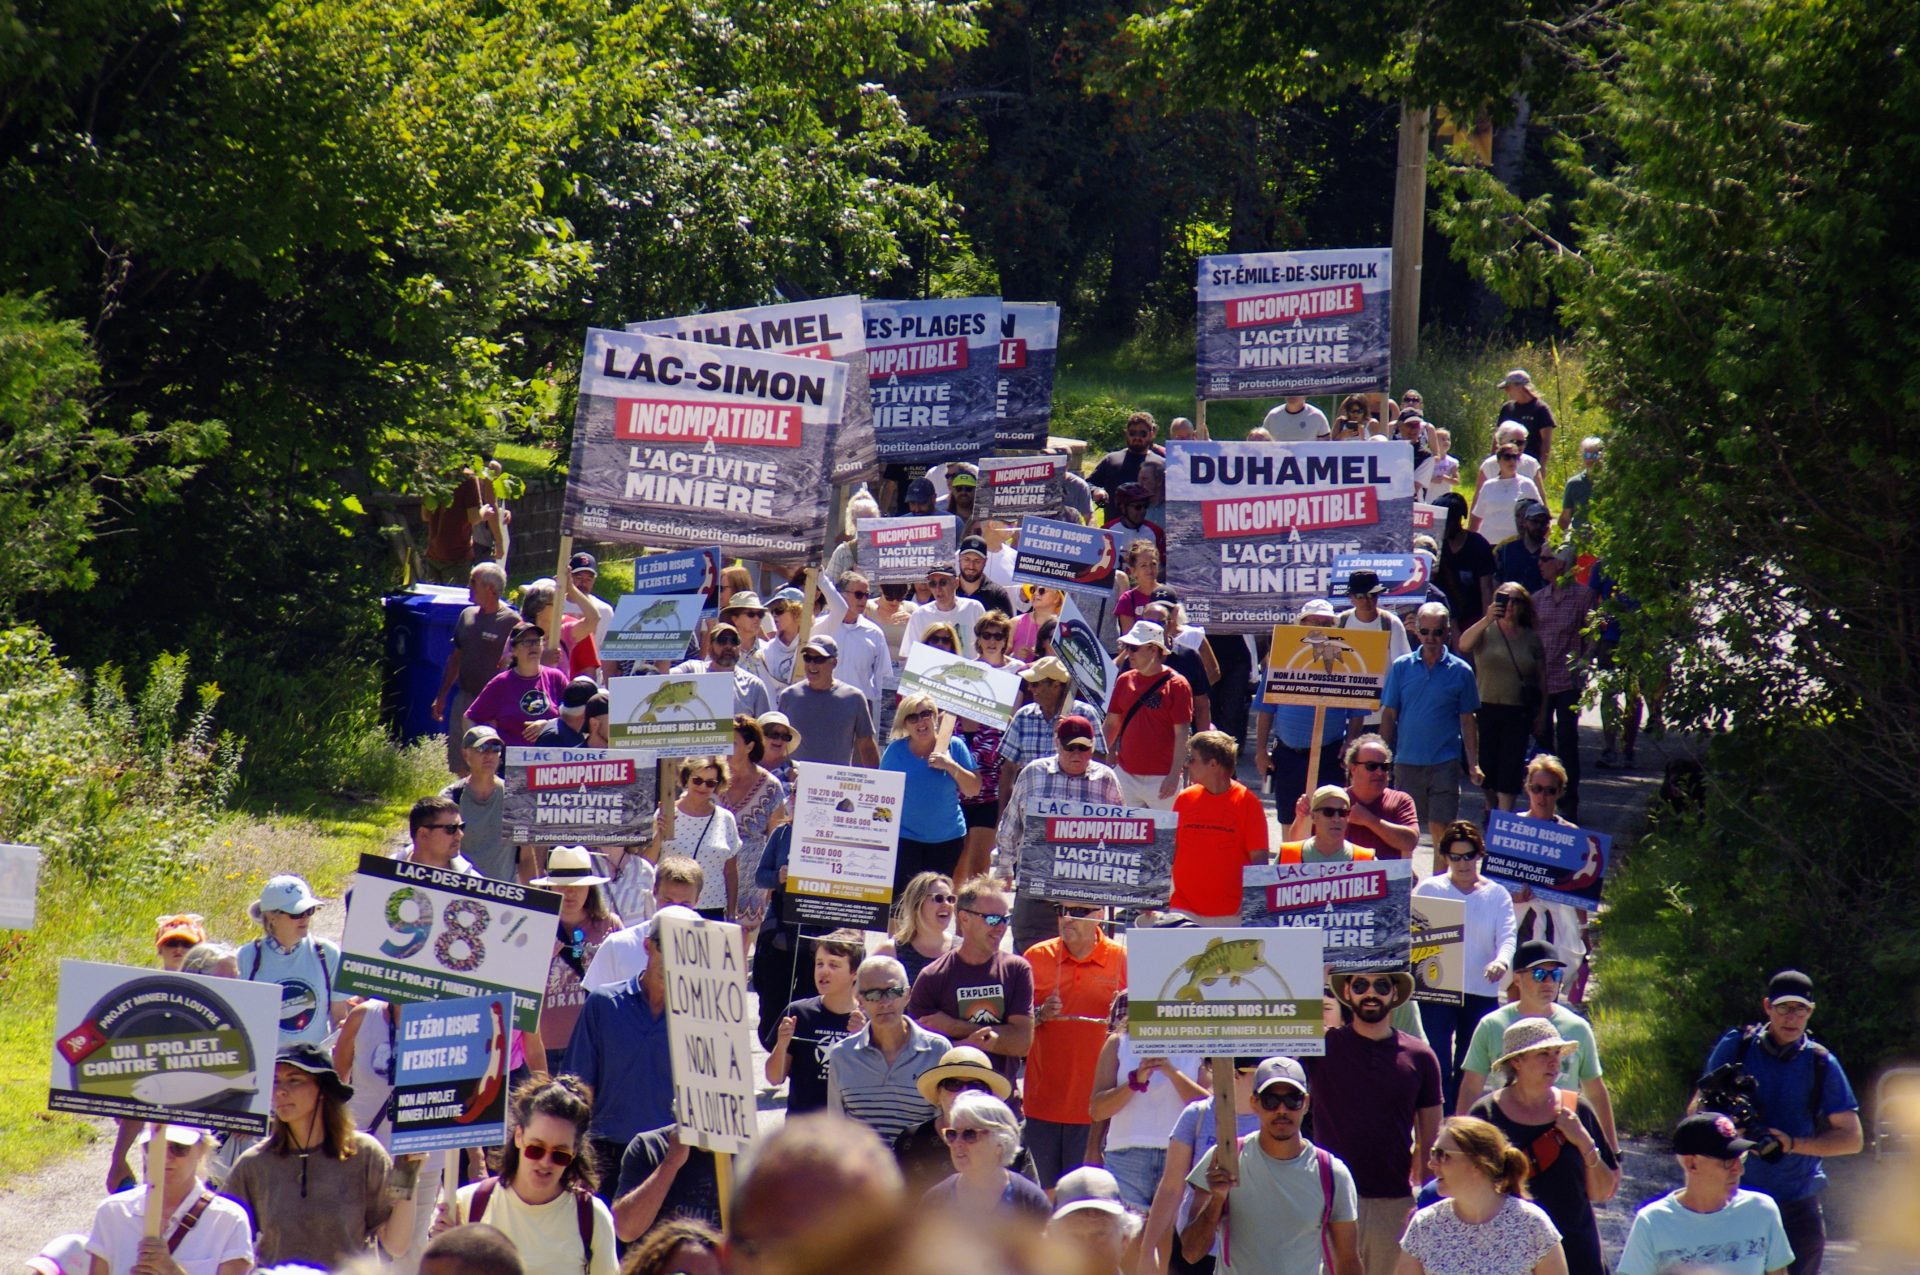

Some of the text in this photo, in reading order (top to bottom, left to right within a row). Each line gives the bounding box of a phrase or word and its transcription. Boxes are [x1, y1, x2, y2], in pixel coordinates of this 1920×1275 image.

[1213, 263, 1377, 286] ST-ÉMILE-DE-SUFFOLK
[1237, 287, 1354, 323] INCOMPATIBLE
[652, 314, 843, 351] HAMEL
[864, 313, 986, 339] ES-PLAGES
[1240, 324, 1349, 345] L'ACTIVITÉ
[868, 342, 958, 374] MPATIBLE
[1239, 343, 1349, 368] MINIÈRE
[603, 348, 825, 406] LAC-SIMON
[1239, 375, 1377, 390] protectionpetitenation.com
[629, 402, 791, 441] INCOMPATIBLE
[703, 436, 716, 454] À
[629, 447, 777, 486] L'ACTIVITÉ
[995, 465, 1049, 482] INCOMPATIBLE
[1190, 455, 1391, 485] DUHAMEL
[624, 471, 775, 517] MINIÈRE
[584, 506, 609, 517] LACS
[1217, 492, 1366, 531] INCOMPATIBLE
[620, 517, 806, 552] protectionpetitenation.com
[877, 525, 937, 543] INCOMPATIBLE
[1027, 524, 1094, 544] LE ZÉRO RISQUE
[1288, 526, 1300, 542] À
[1024, 537, 1081, 555] N'EXISTE PAS
[639, 557, 695, 574] LE ZÉRO RISQUE
[1019, 563, 1041, 573] MINIER
[1052, 569, 1076, 578] LOUTRE
[1020, 556, 1034, 564] NON
[1045, 561, 1070, 570] PROJET
[638, 574, 687, 589] N'EXISTE PAS
[1221, 564, 1332, 592] MINIÈR
[1290, 671, 1295, 679] À
[1308, 674, 1347, 683] POUSSIÈRE
[1349, 676, 1379, 685] TOXIQUE
[978, 697, 997, 708] LACS
[627, 722, 716, 735] PROTÉGEONS NOS LACS
[641, 738, 667, 746] PROJET
[702, 735, 727, 743] LOUTRE
[523, 750, 551, 761] LAC
[535, 763, 628, 785] INCOMPATIBLE
[537, 792, 623, 806] L'ACTIVITÉ
[880, 796, 895, 804] 000
[1038, 802, 1071, 815] LAC
[536, 807, 622, 824] MINIÈRE
[1055, 820, 1147, 840] INCOMPATIBLE
[1496, 819, 1576, 846] LE ZÉRO RISQUE
[801, 846, 842, 857] 40 100 000
[1056, 846, 1141, 866] L'ACTIVITÉ
[1492, 834, 1562, 859] N'EXISTE PAS
[832, 863, 842, 874] 13
[1053, 861, 1140, 885] MINIÈRE
[1277, 866, 1309, 880] LAC
[1487, 864, 1555, 885] MINIER LA LOUTRE
[1488, 856, 1548, 875] NON AU PROJET
[395, 863, 526, 901] LAC-DES-PLAGES
[798, 880, 832, 893] NON
[1276, 875, 1379, 907] INCOMPATIBLE
[1051, 888, 1163, 906] protectionpetitenation.com
[1425, 931, 1460, 941] LOUTRE
[673, 926, 735, 972] NON À
[343, 959, 384, 978] CONTRE
[386, 970, 398, 981] LE
[400, 972, 441, 990] PROJET
[442, 979, 476, 997] MINIER
[667, 970, 743, 1024] LOMIKO
[960, 987, 1000, 998] EXPLORE
[99, 993, 220, 1029] PROJET MINIER LA LOUTRE
[1157, 1002, 1296, 1018] PROTÉGEONS NOS LACS
[405, 1014, 480, 1040] LE ZÉRO RISQUE
[1139, 1025, 1313, 1036] NON AU PROJET MINIER LA LOUTRE
[111, 1038, 219, 1059] UN PROJET
[402, 1045, 468, 1071] N'EXISTE PAS
[685, 1032, 741, 1081] NON À
[83, 1051, 239, 1077] CONTRE NATURE
[398, 1089, 456, 1107] NON AU PROJET
[397, 1104, 463, 1122] MINIER LA LOUTRE
[677, 1084, 750, 1139] LA LOUTRE
